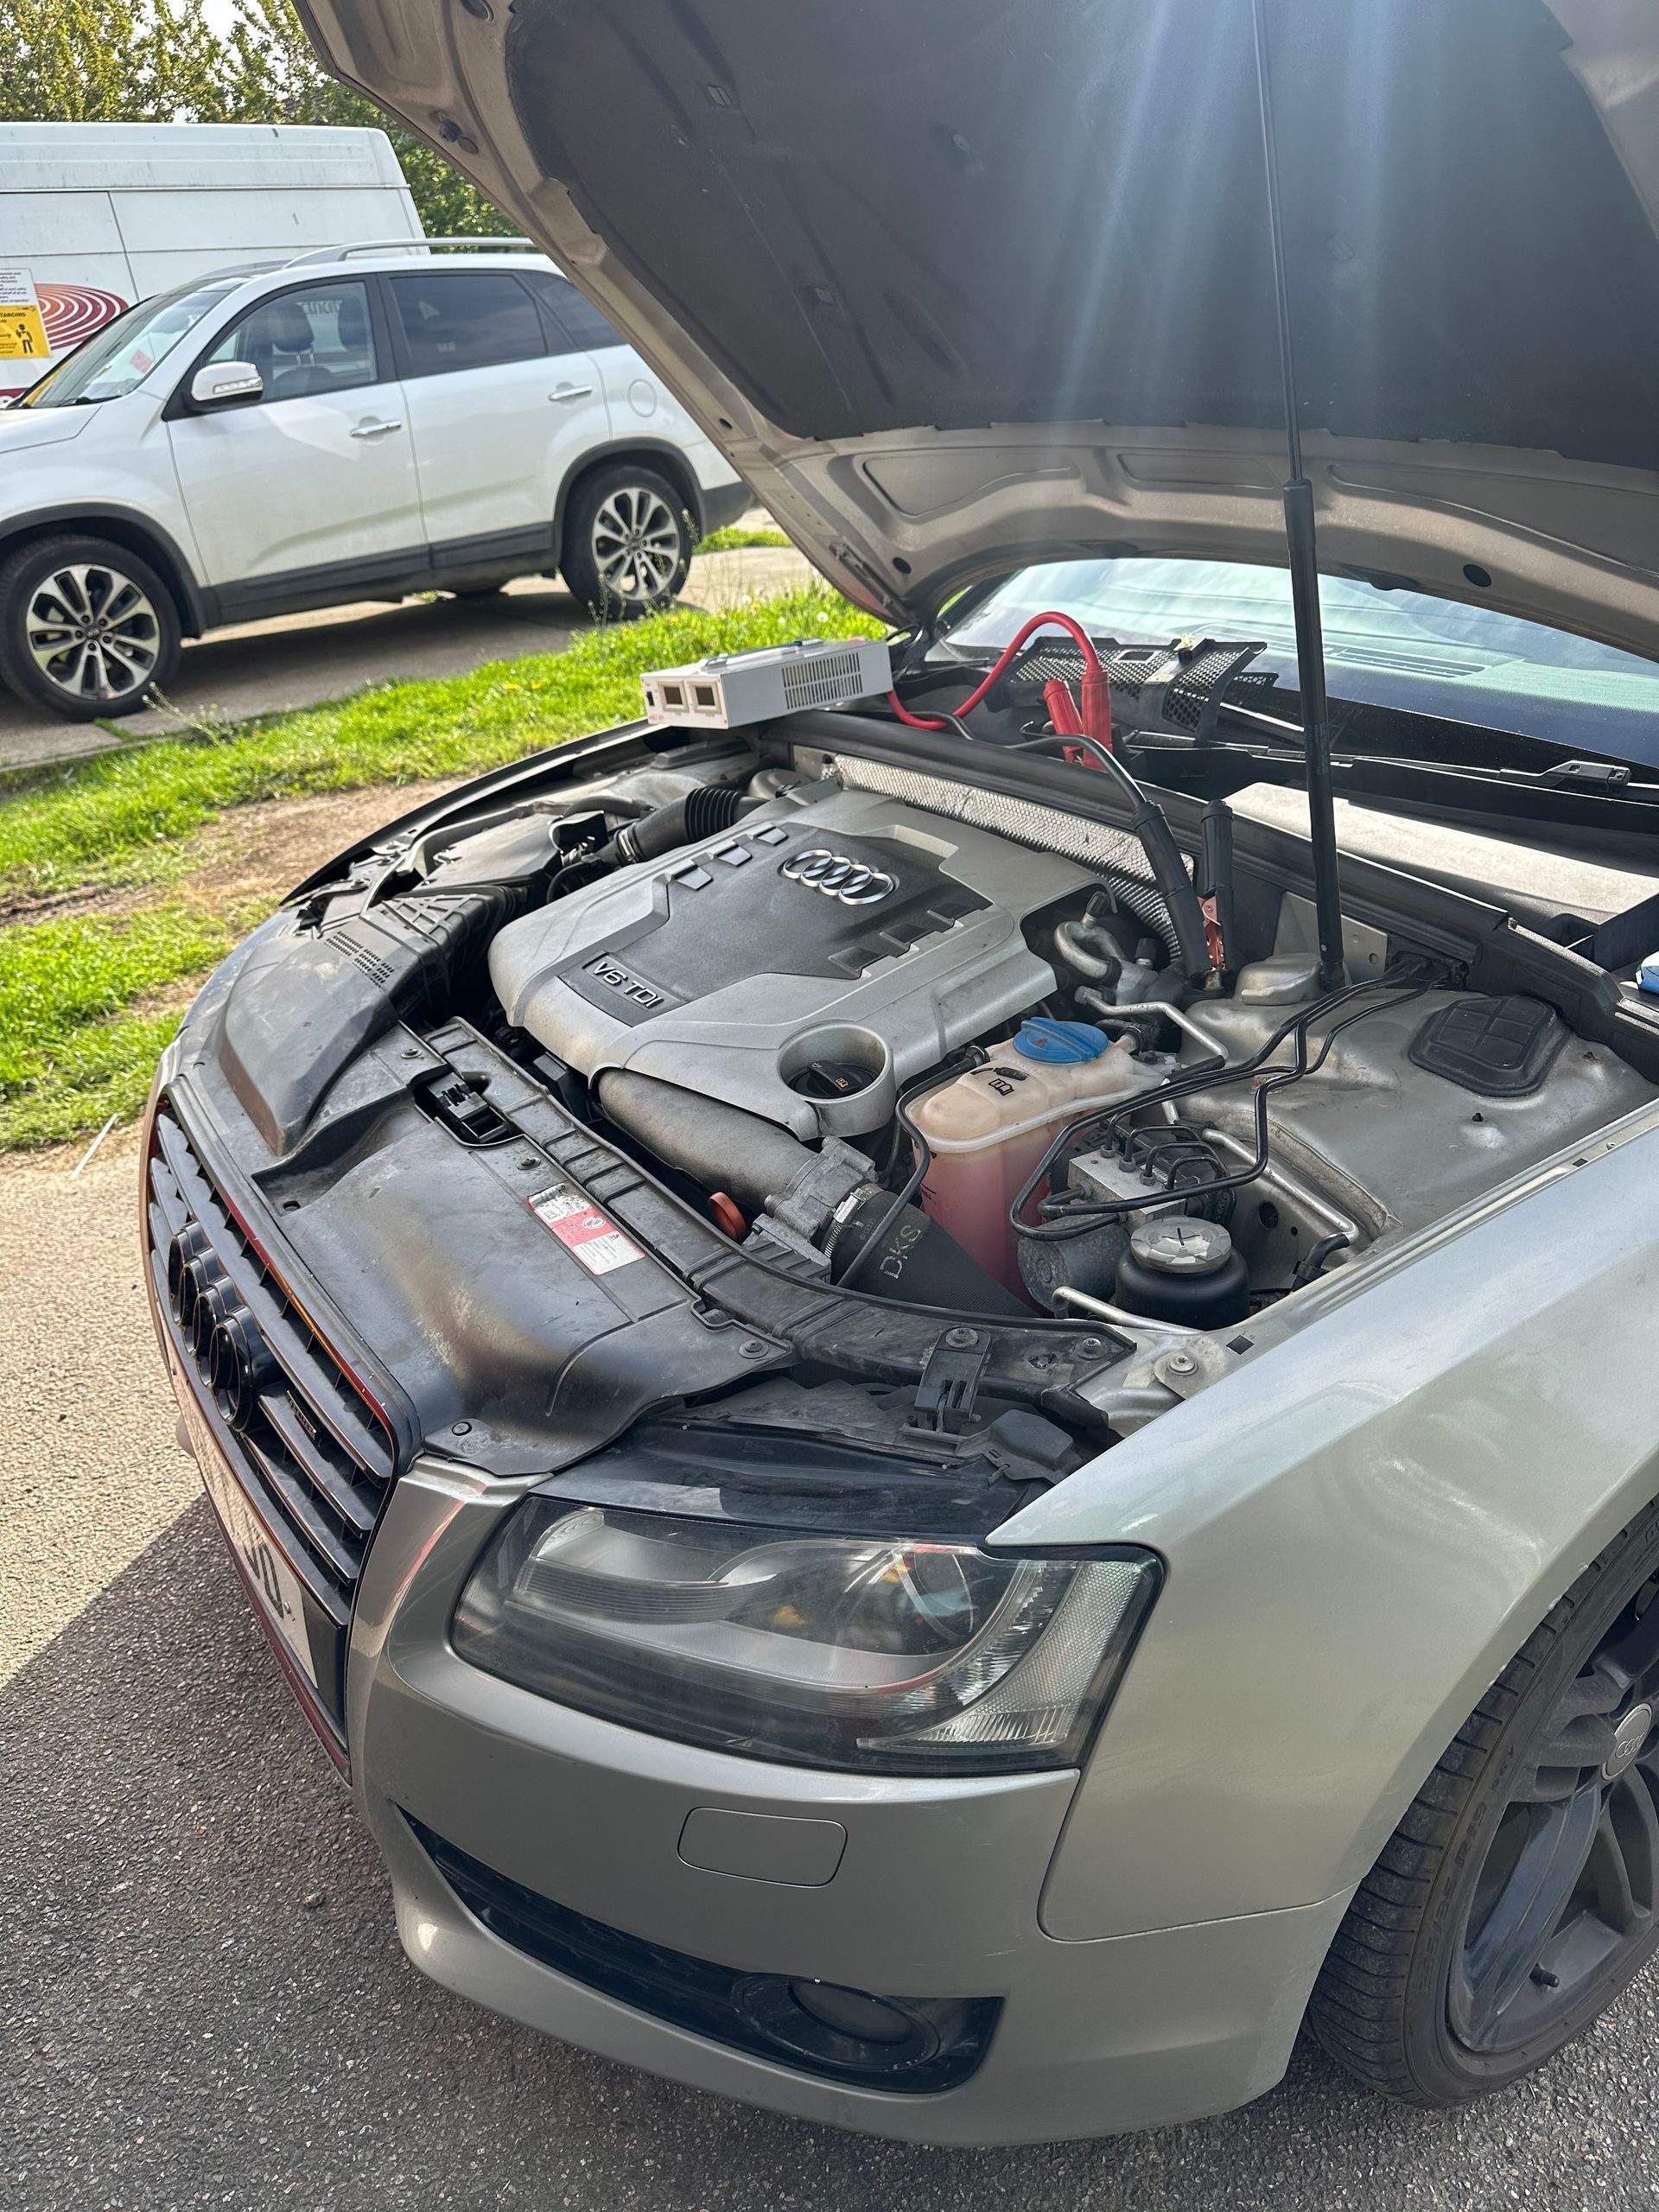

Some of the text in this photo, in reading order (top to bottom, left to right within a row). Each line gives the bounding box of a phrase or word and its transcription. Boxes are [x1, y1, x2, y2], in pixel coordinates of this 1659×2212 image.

[594, 961, 664, 1009] V6 TDI
[880, 1224, 921, 1279] DKS
